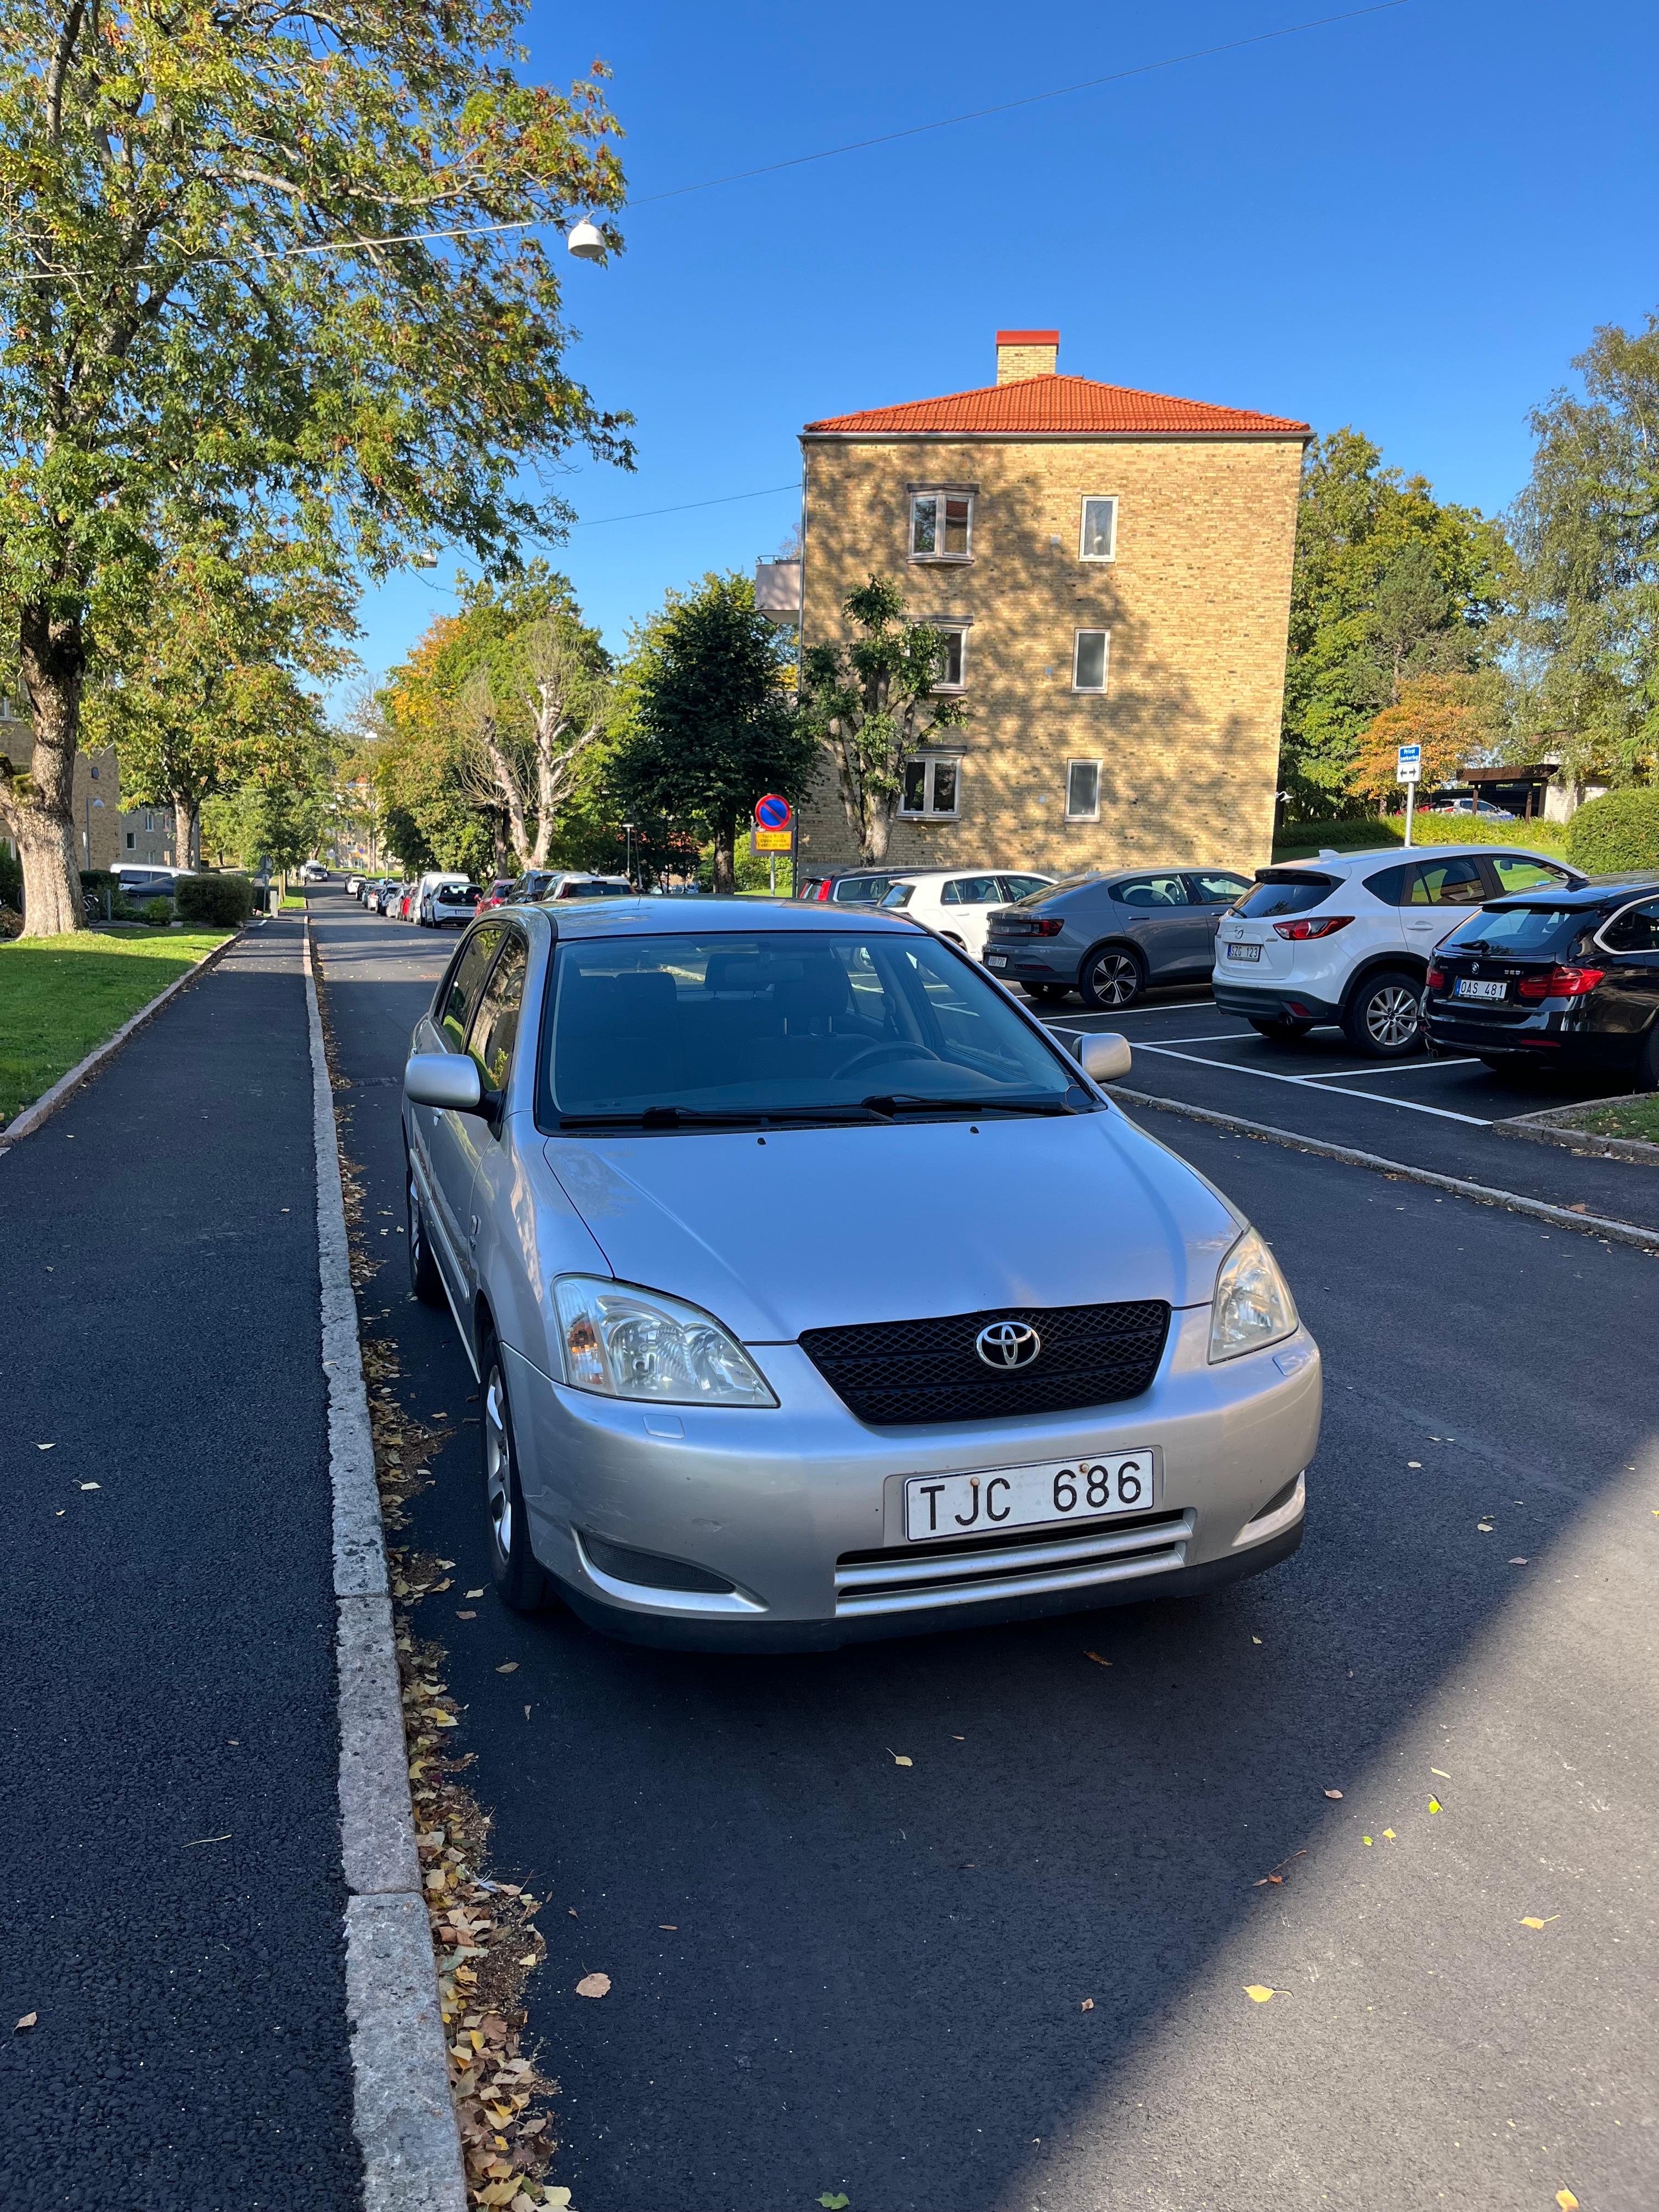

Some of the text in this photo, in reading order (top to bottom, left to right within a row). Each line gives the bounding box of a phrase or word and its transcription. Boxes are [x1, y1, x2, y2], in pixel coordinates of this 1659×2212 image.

[1231, 946, 1258, 958] SZG 123
[1460, 981, 1503, 997] OAS 481
[920, 1461, 1142, 1531] TJC 686
